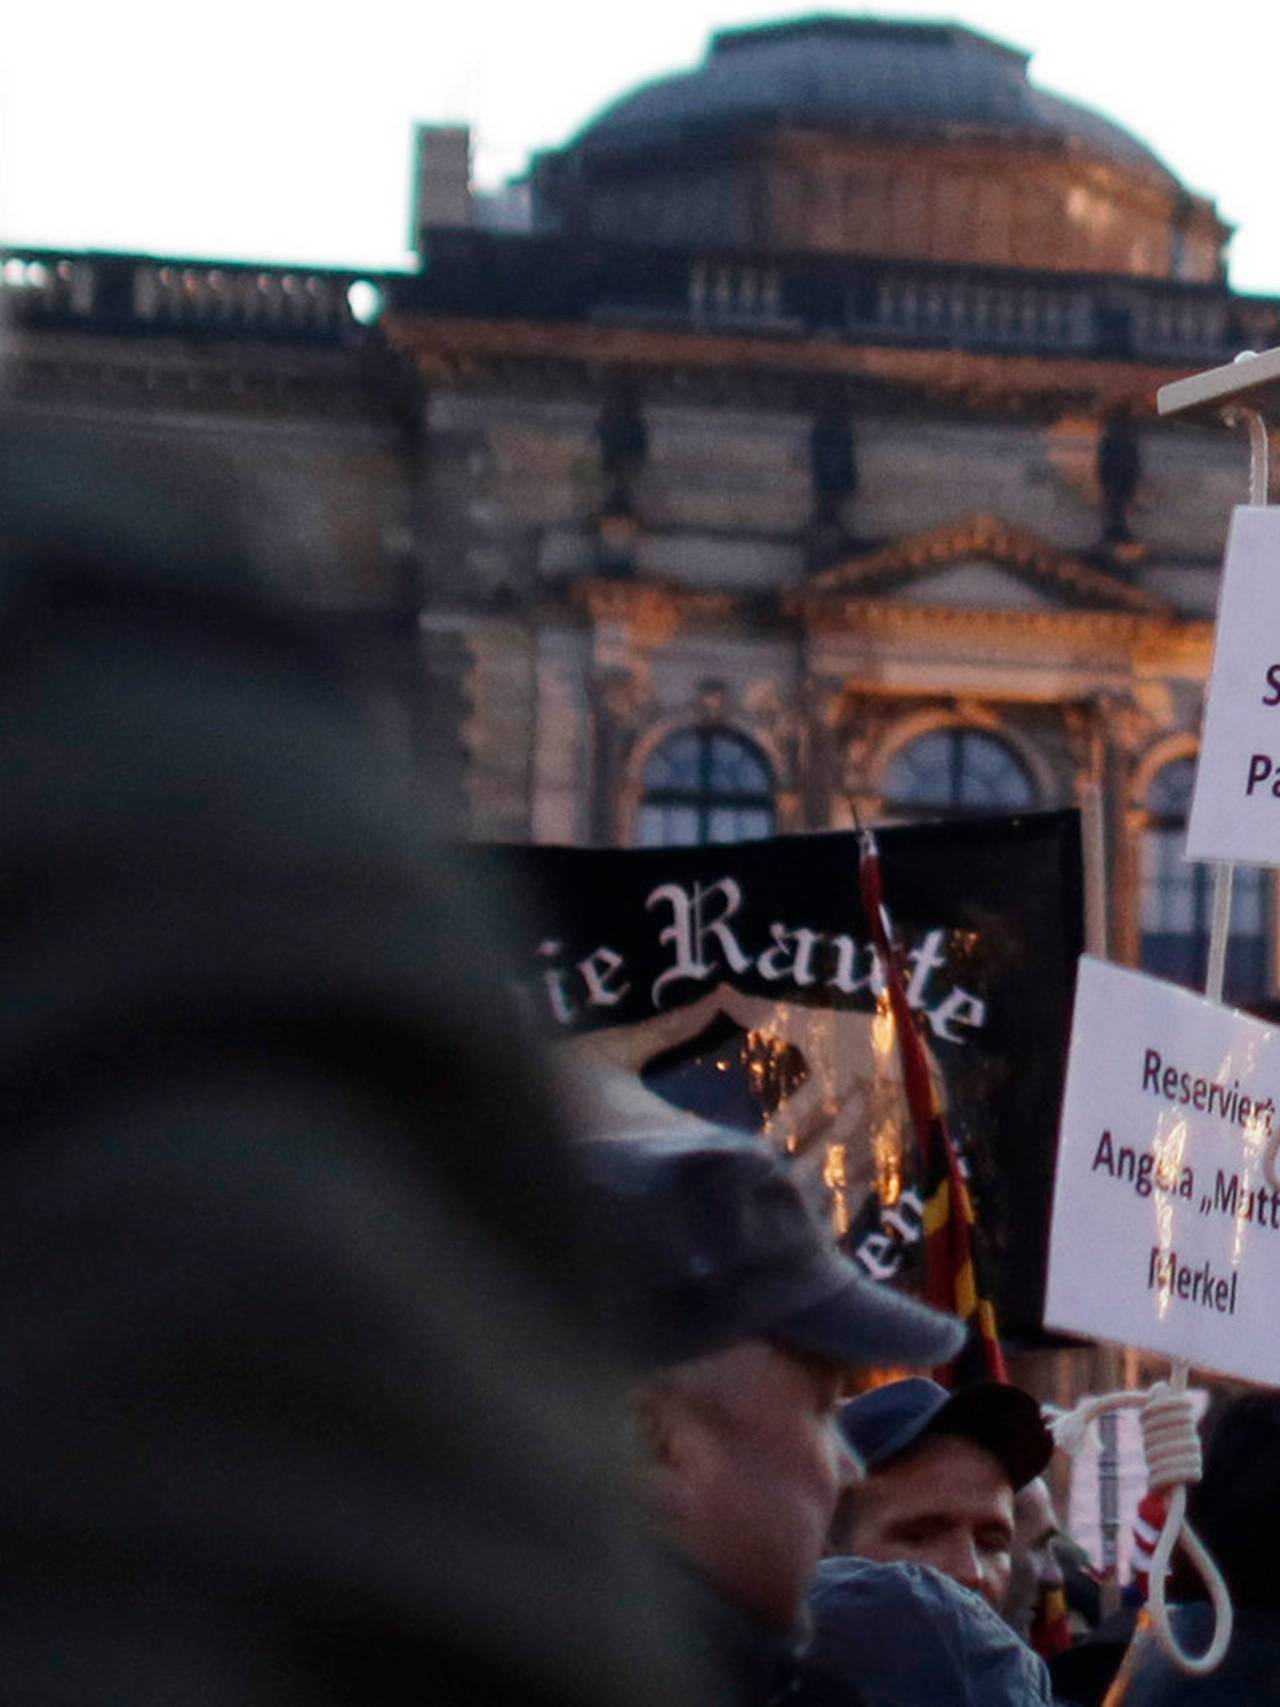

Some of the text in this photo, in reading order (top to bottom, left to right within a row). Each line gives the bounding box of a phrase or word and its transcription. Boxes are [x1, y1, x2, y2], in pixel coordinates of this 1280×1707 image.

[534, 875, 986, 1044] ie Raute
[1147, 1246, 1238, 1316] Merkel
